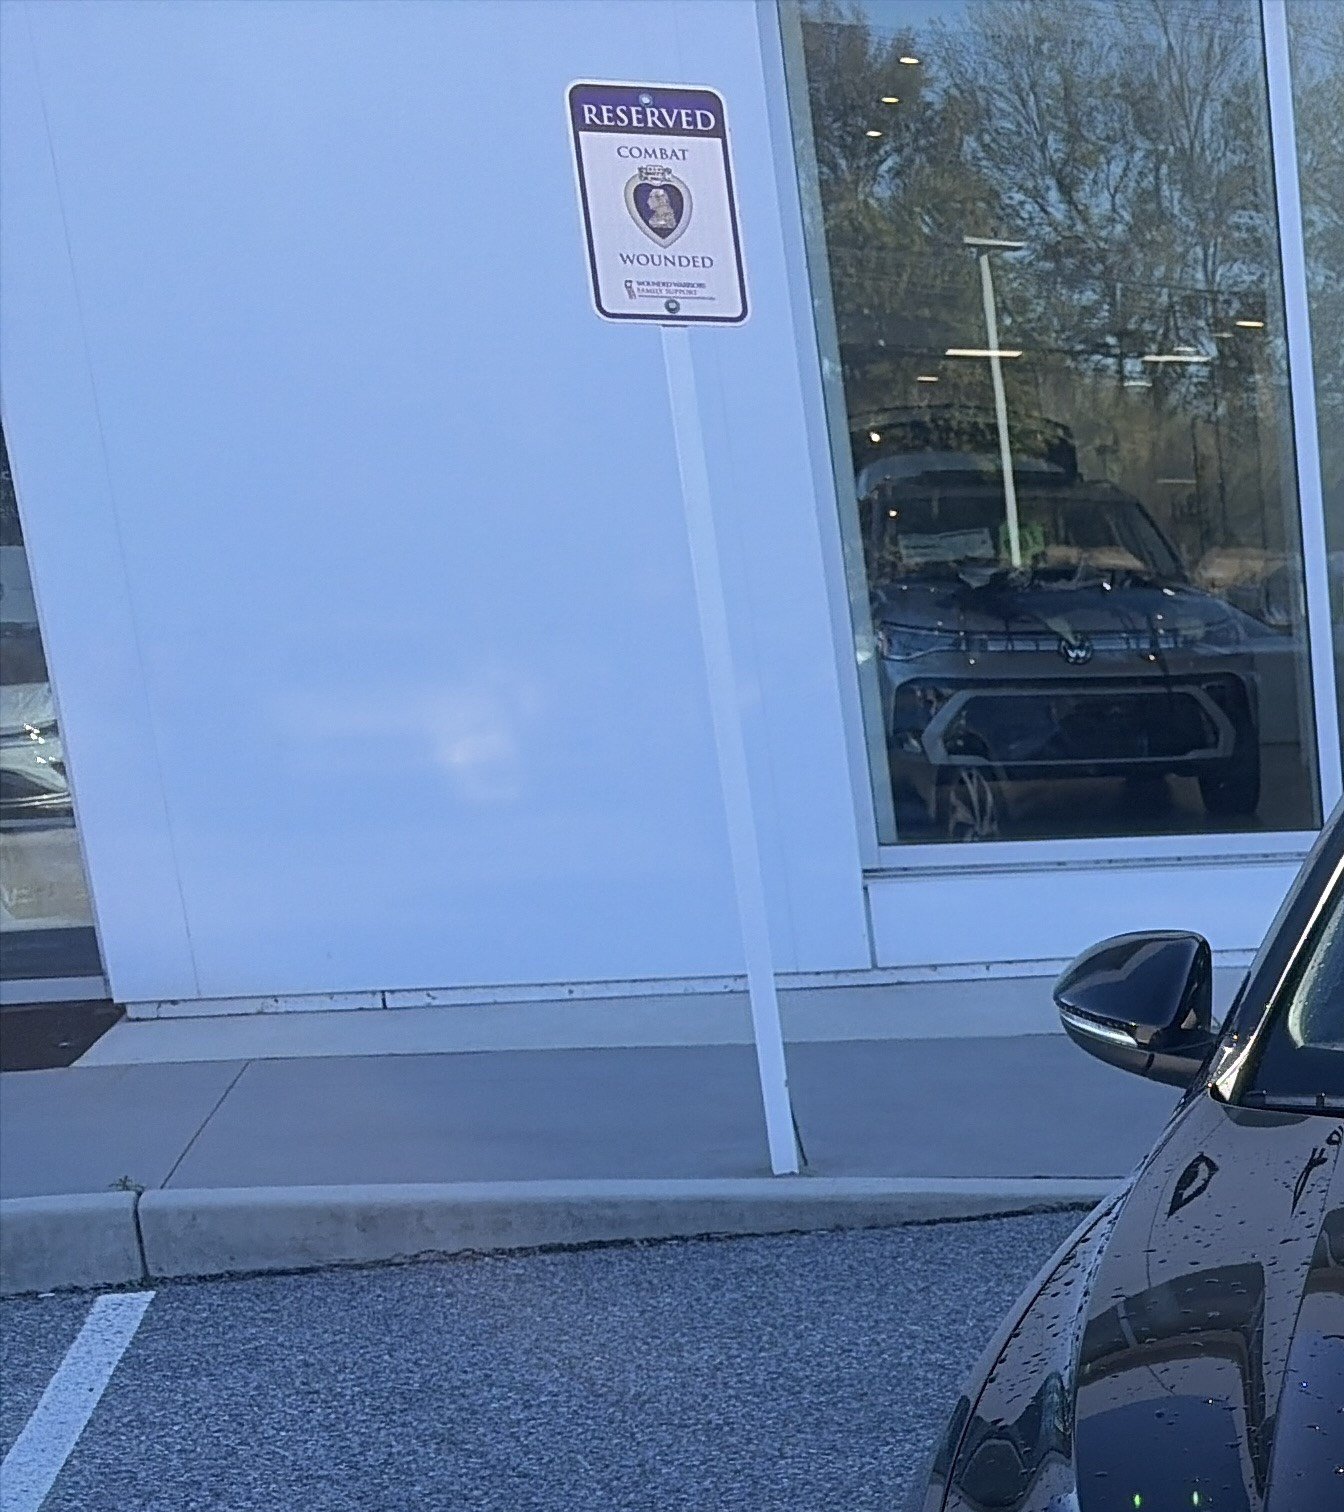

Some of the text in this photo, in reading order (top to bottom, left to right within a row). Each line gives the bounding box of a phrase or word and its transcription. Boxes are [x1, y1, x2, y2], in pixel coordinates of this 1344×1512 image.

[581, 104, 716, 131] RESERVED
[616, 145, 689, 161] COMBAT
[619, 252, 714, 269] WOUNDED
